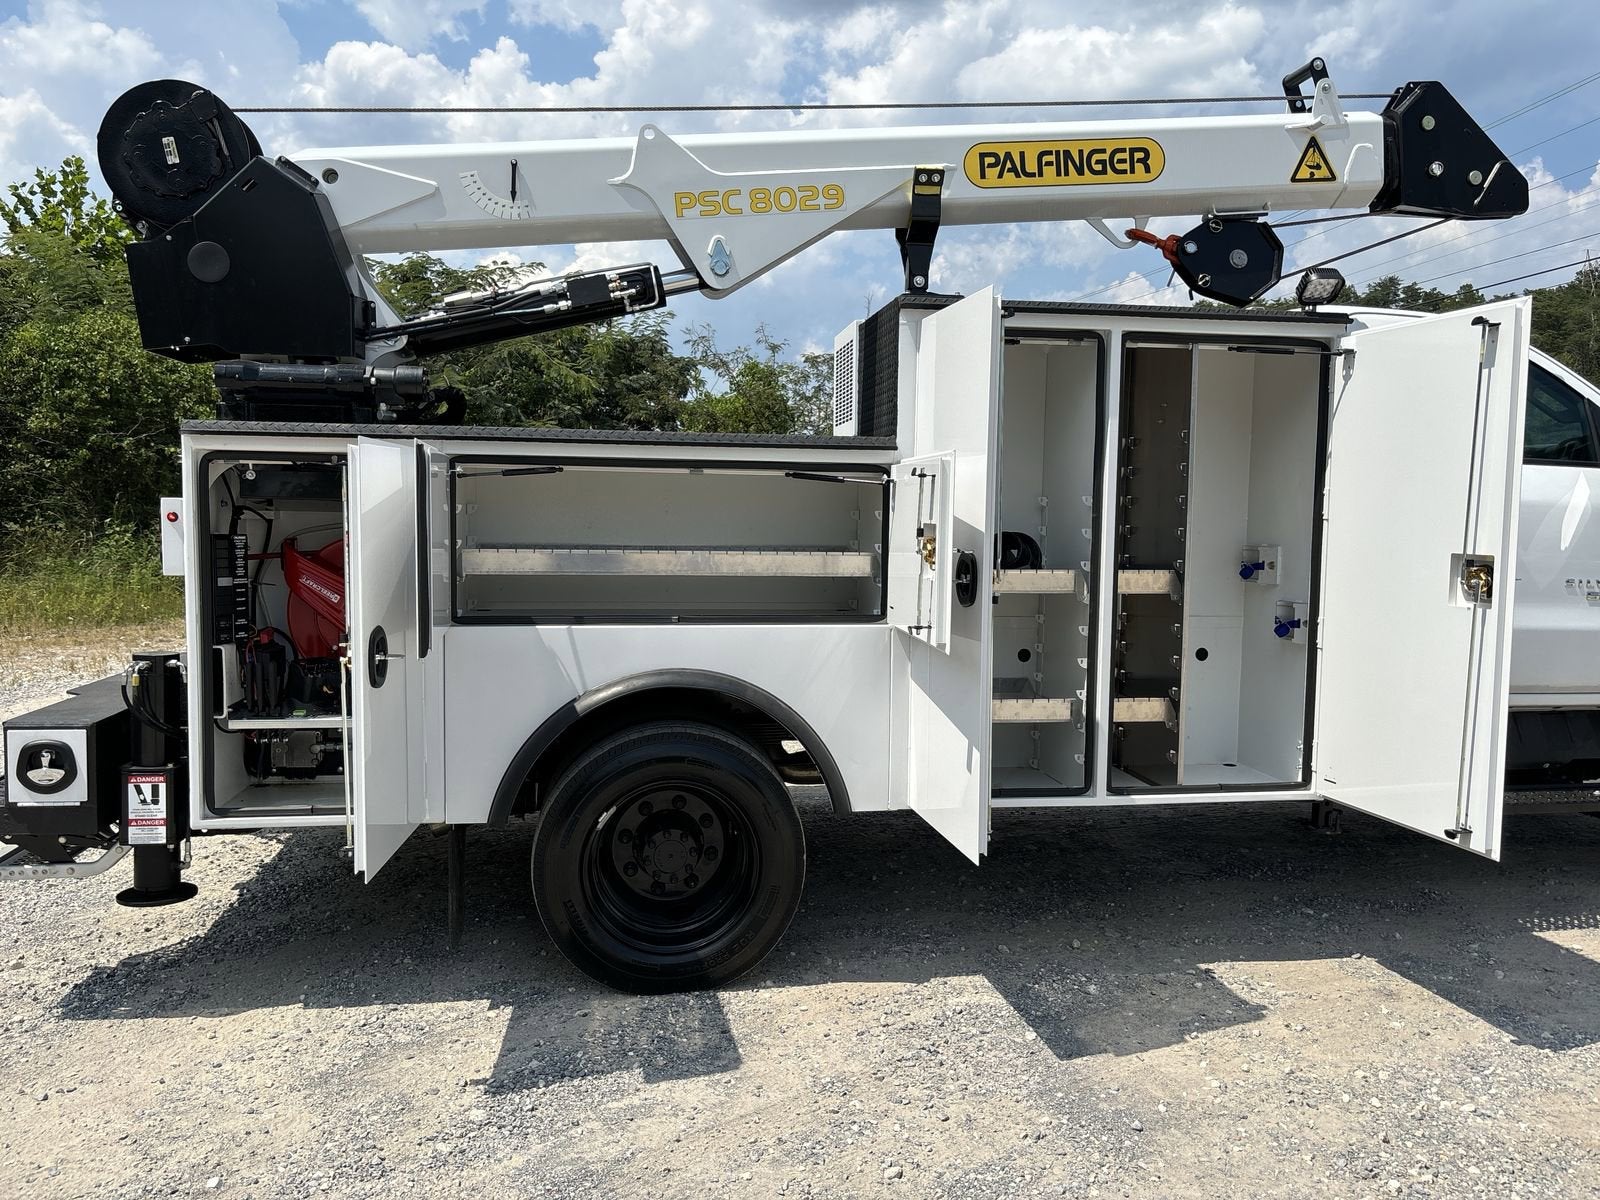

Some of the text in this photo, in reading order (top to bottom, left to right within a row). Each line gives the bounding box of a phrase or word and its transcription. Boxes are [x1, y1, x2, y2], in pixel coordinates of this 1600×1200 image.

[978, 146, 1151, 180] PALFINGER
[674, 184, 845, 218] PSC 8029
[302, 574, 335, 600] REELCRAFT
